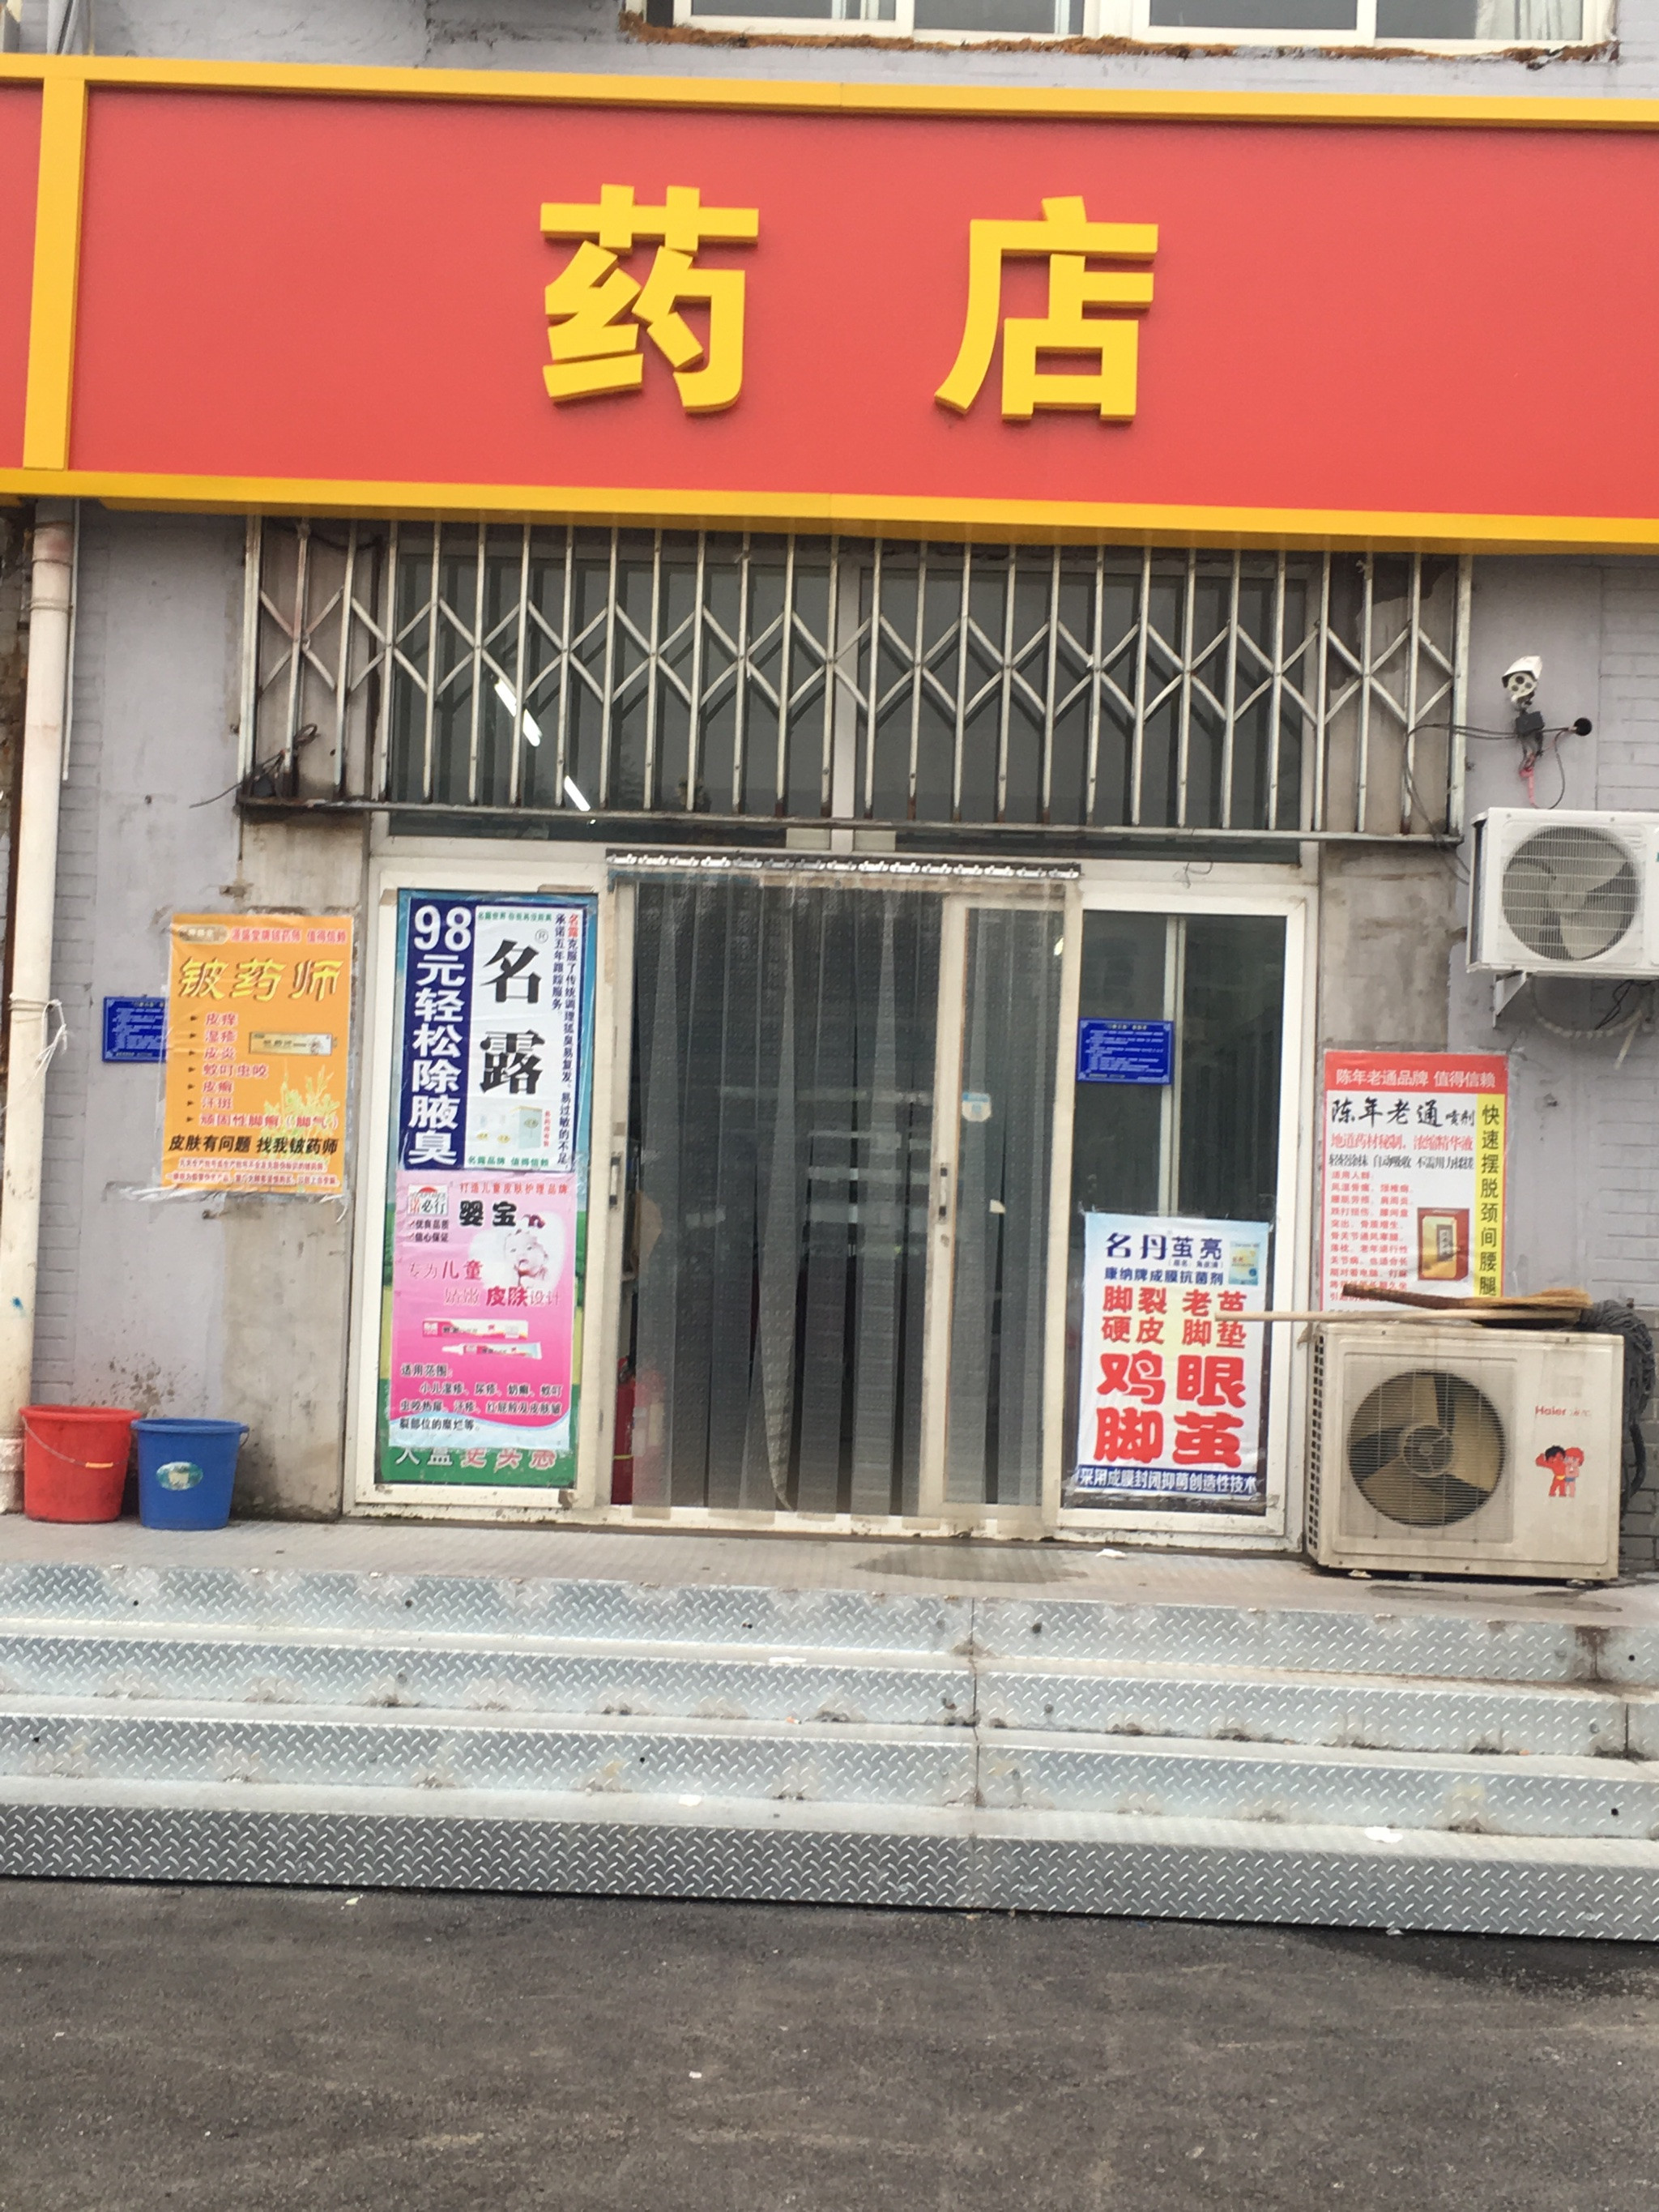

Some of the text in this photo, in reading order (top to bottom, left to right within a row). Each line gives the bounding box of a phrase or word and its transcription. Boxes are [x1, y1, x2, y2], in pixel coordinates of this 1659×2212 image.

[540, 184, 1158, 421] 药店
[1337, 1069, 1495, 1088] 陈年老通品牌 值得信赖
[168, 1134, 252, 1152] 皮肤有问题
[459, 1200, 517, 1226] 婴宝
[416, 1232, 449, 1242] 信心保证
[1104, 1266, 1223, 1286] 康纳牌成膜抗菌剂
[1102, 1285, 1167, 1314] 脚裂
[1101, 1316, 1247, 1348] 硬皮 脚垫
[1097, 1350, 1247, 1408] 鸡眼
[1094, 1407, 1243, 1468] 脚茧
